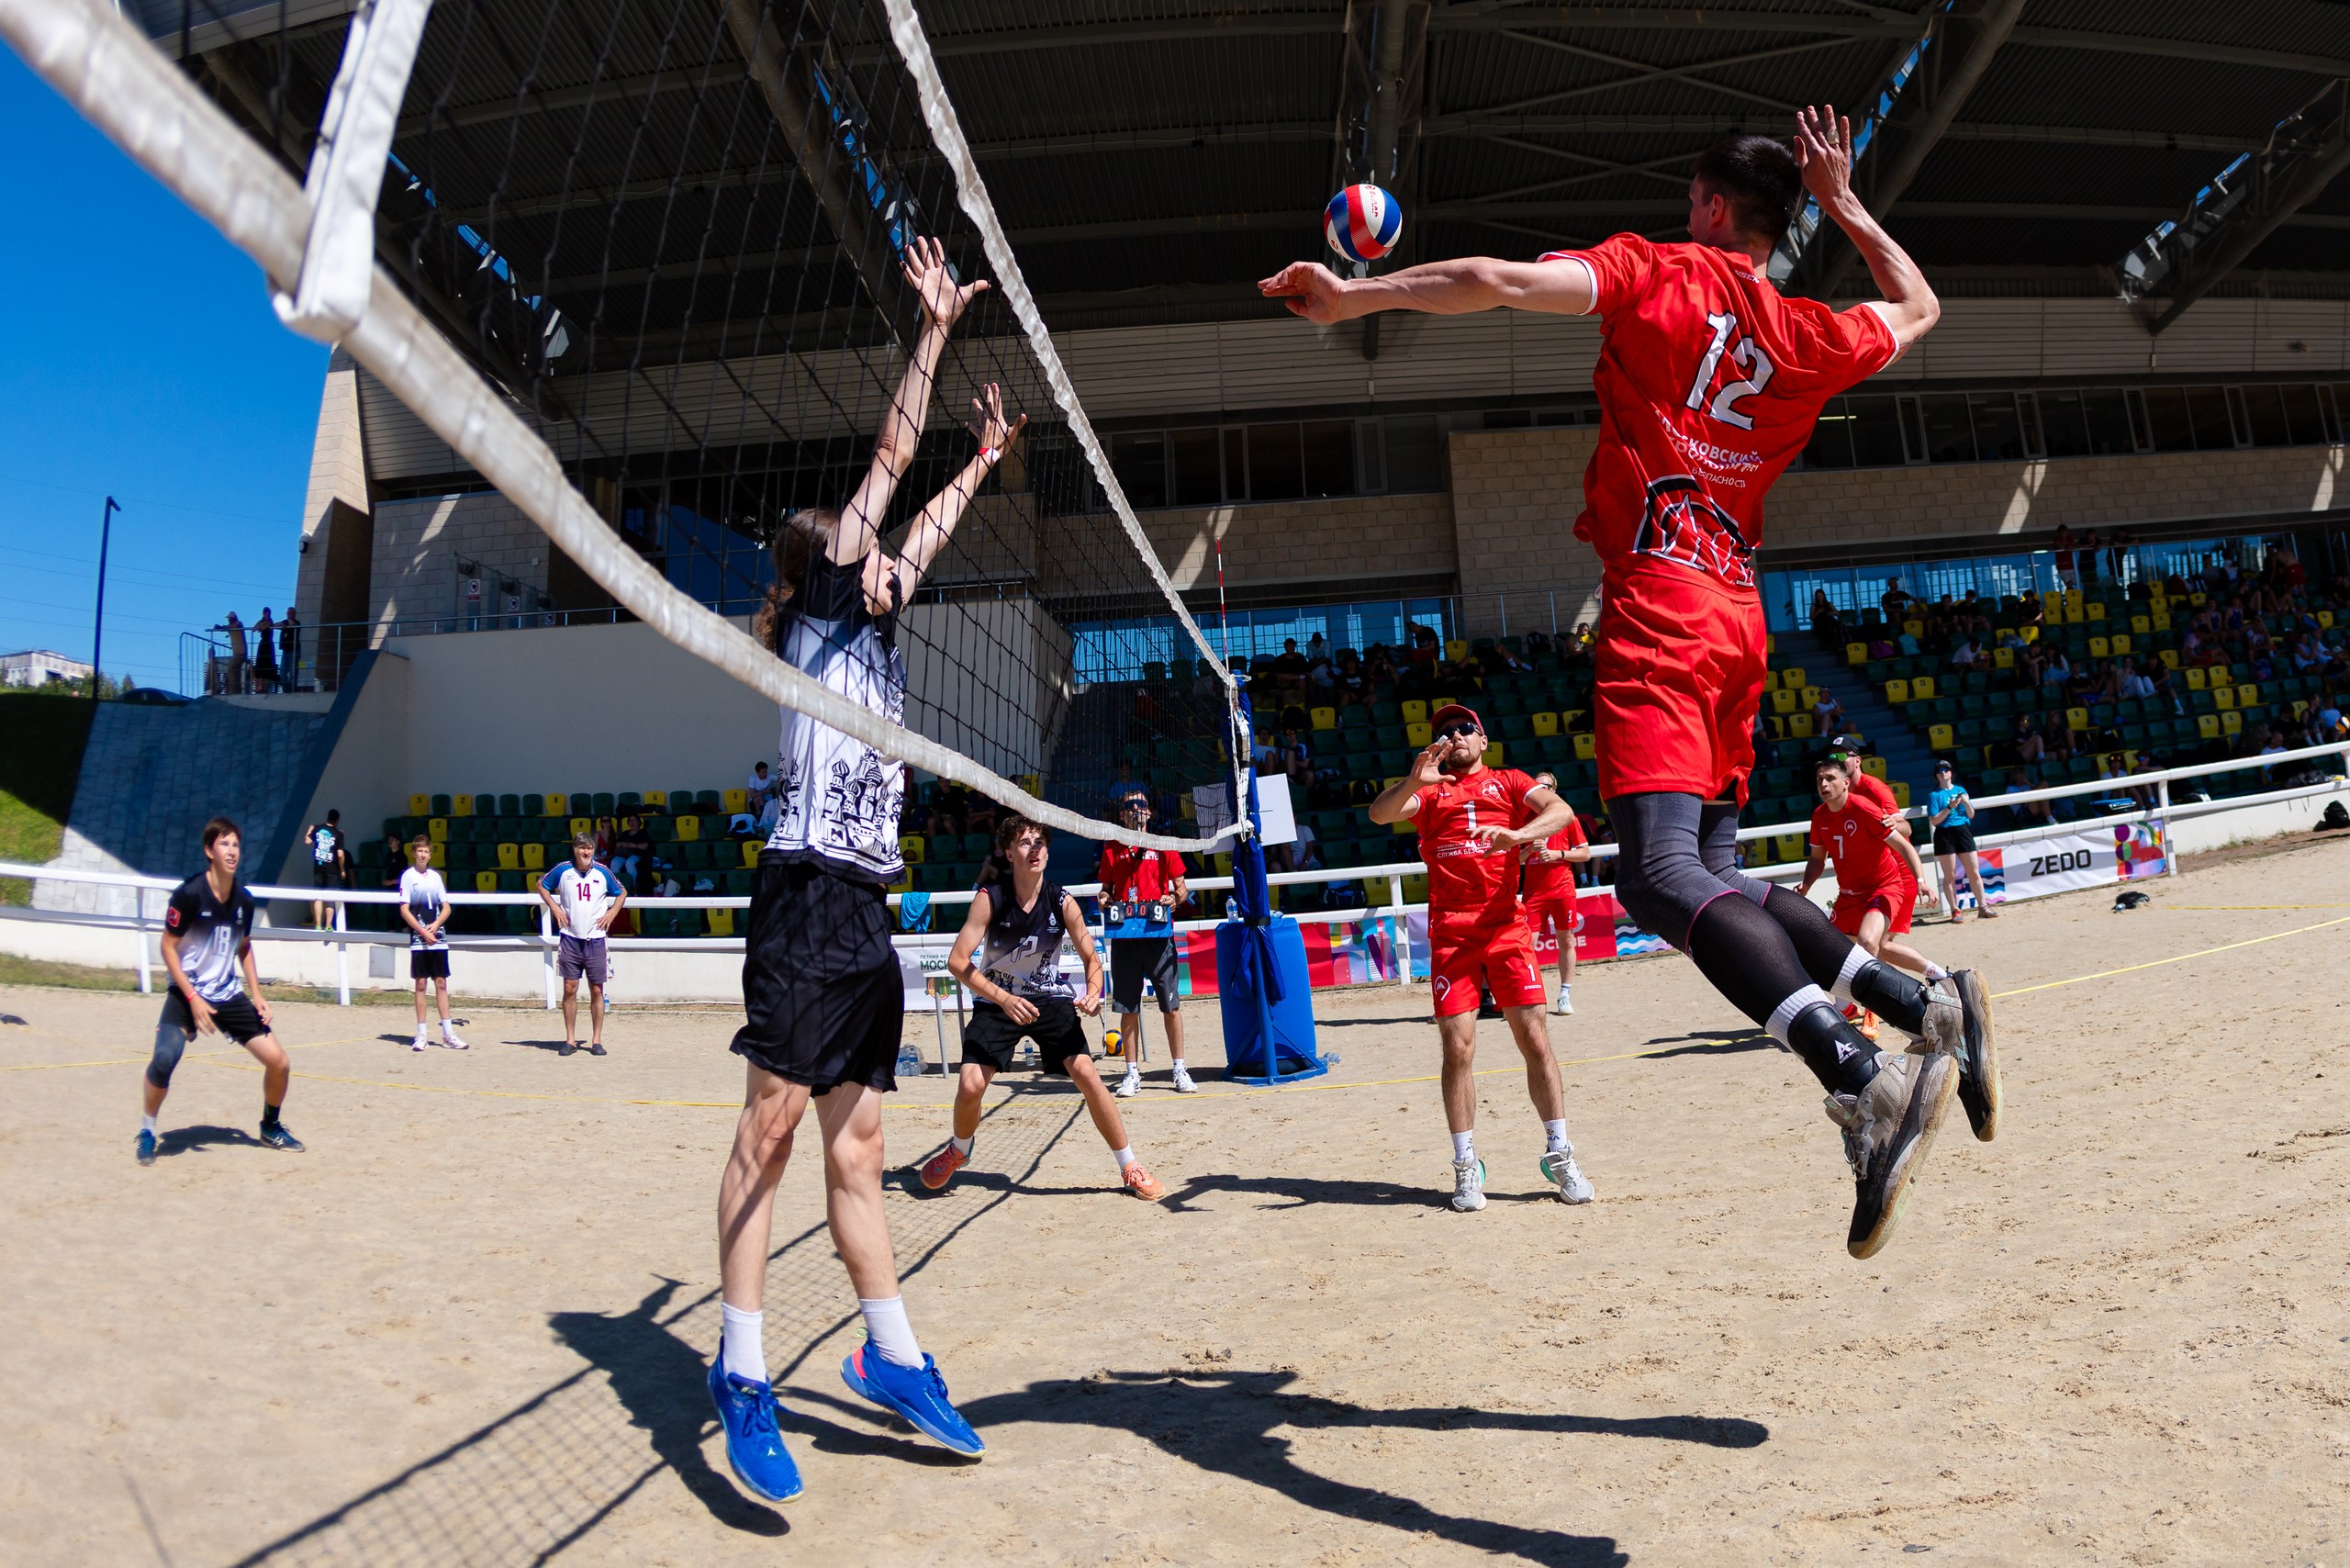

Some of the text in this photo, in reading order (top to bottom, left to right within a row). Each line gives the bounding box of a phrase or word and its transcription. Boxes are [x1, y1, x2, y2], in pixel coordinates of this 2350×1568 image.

[1685, 311, 1774, 431] 12
[1463, 801, 1477, 832] 1
[908, 839, 914, 847] 04
[1437, 848, 1462, 858] СЛУЖБА
[1833, 835, 1842, 858] 7
[2030, 849, 2091, 877] ZEDO
[576, 882, 591, 902] 14
[1110, 905, 1163, 921] 6 0 0 9
[213, 925, 231, 957] 18
[920, 959, 948, 970] МОСК
[1528, 964, 1536, 981] 1
